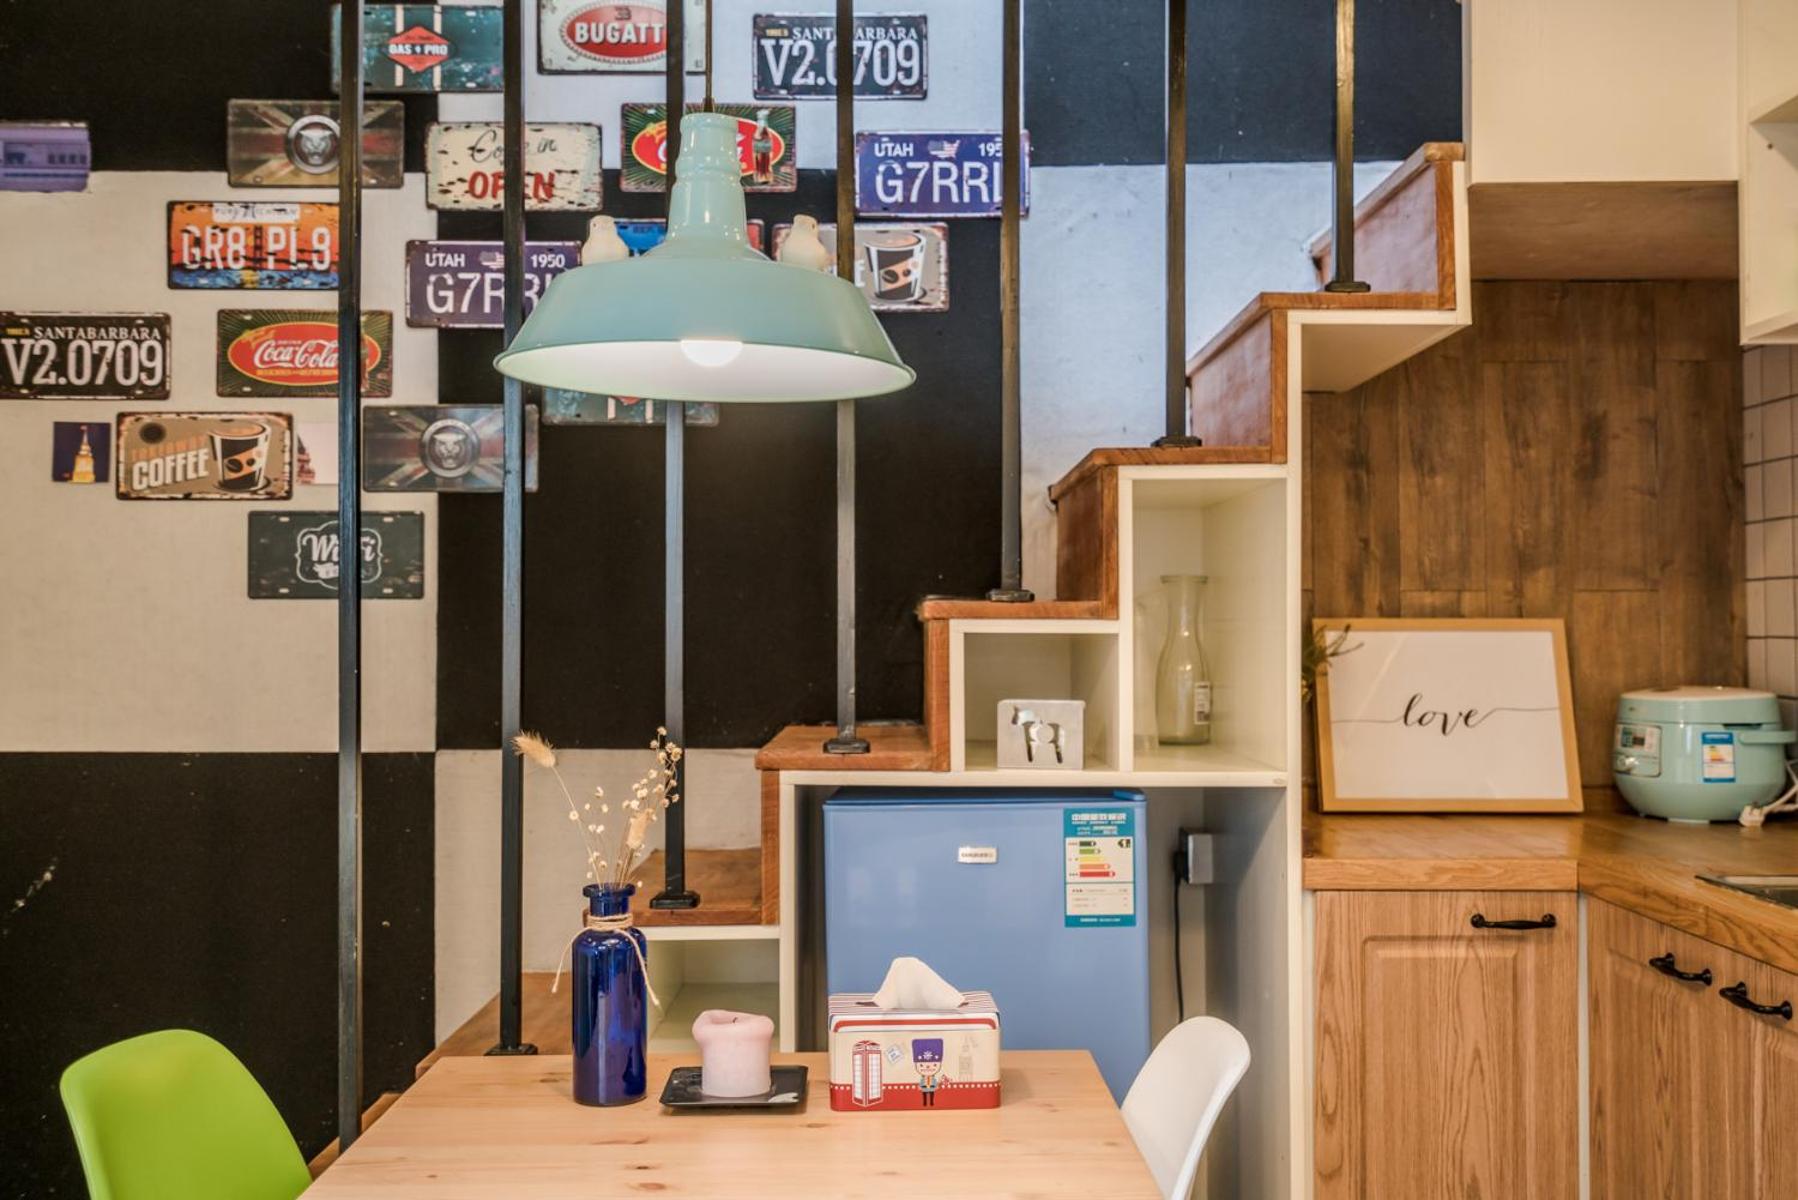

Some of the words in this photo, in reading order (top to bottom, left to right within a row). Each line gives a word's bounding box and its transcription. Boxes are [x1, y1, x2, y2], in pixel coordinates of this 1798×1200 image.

[574, 22, 664, 44] BUGATT
[792, 26, 918, 41] SANTARBARA
[424, 43, 448, 55] PRO
[874, 142, 914, 157] UTAH
[978, 142, 1002, 157] 195
[468, 170, 556, 201] OPN
[181, 224, 246, 270] GR8
[425, 253, 465, 268] UTAH
[530, 254, 566, 268] 1950
[426, 273, 553, 314] G7RR
[34, 326, 161, 340] SANTABARBARA
[1, 338, 163, 386] V2.0709
[132, 447, 209, 491] COFFEE
[1402, 692, 1482, 736] love
